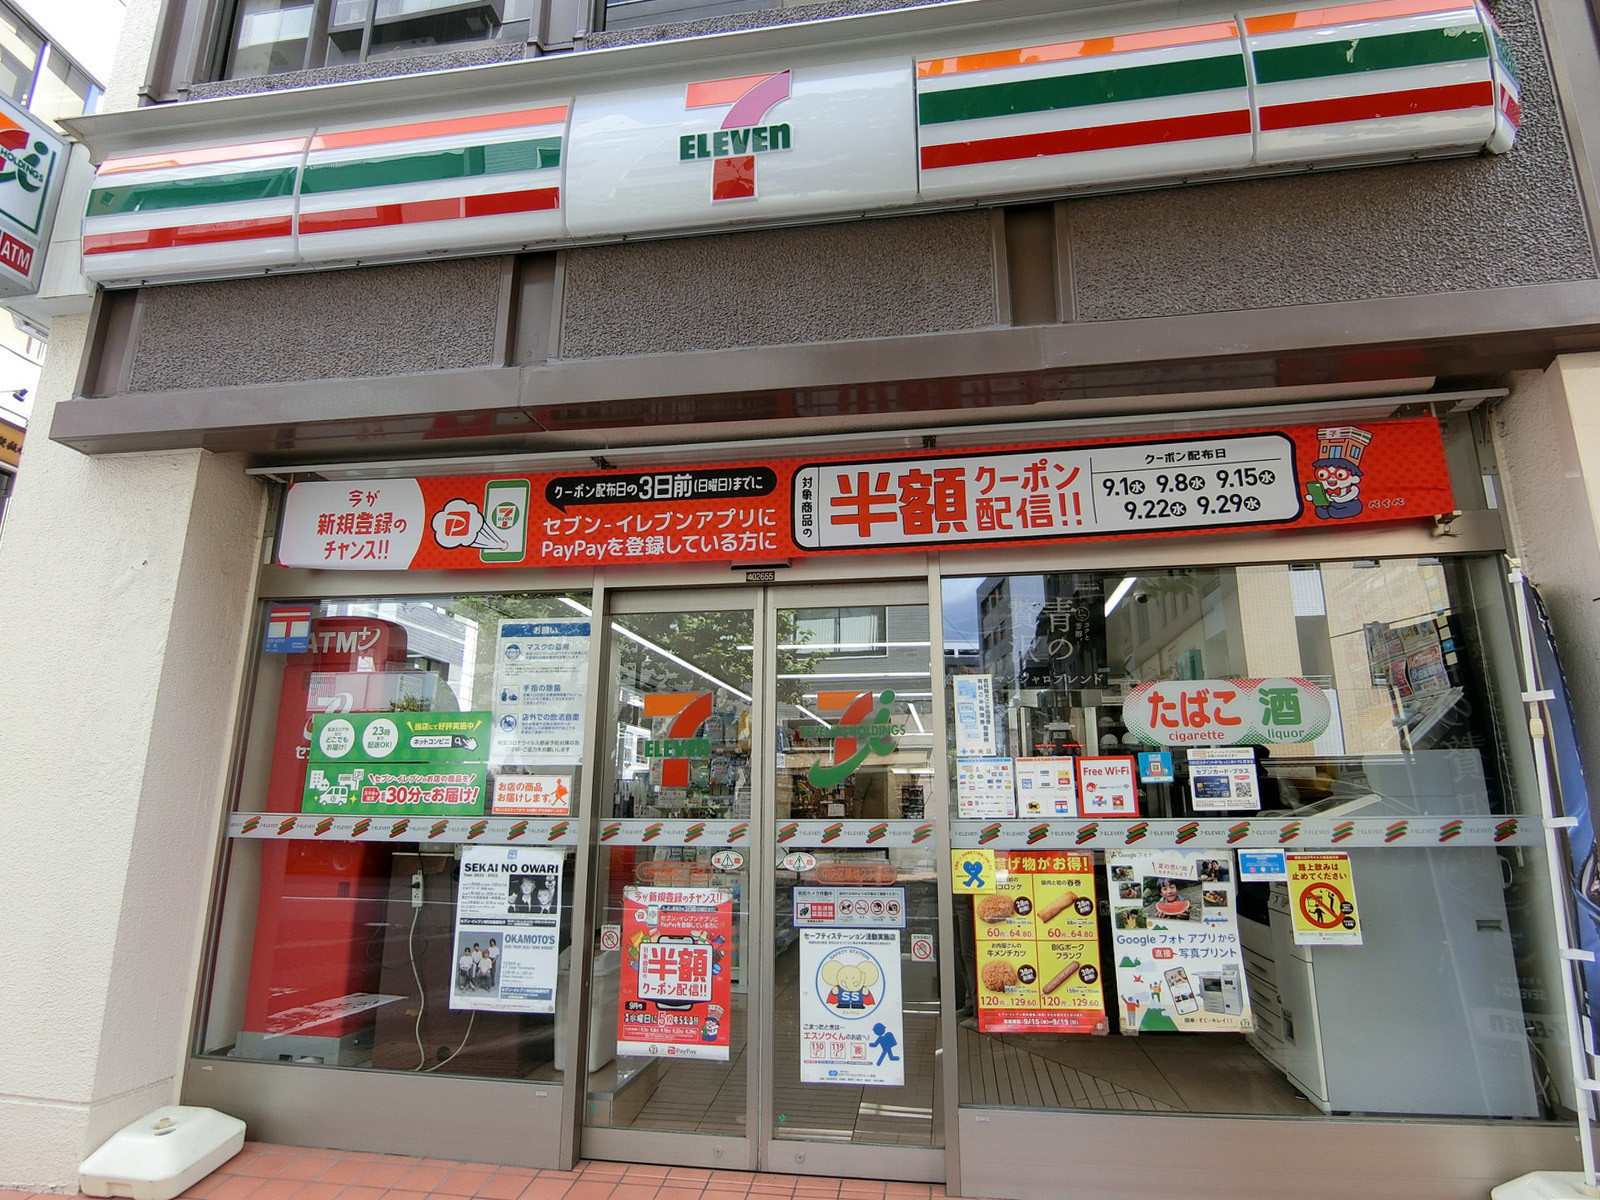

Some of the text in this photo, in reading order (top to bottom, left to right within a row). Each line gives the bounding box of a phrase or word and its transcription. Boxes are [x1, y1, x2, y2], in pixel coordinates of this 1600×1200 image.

[1, 149, 44, 183] HOLDINGS
[1, 241, 31, 270] ATM
[1144, 448, 1227, 465] クーポン配布日
[974, 458, 1082, 495] クーポン
[349, 489, 380, 508] 今が
[830, 467, 969, 538] 半額
[801, 476, 814, 538] 対象商品の
[316, 512, 407, 536] 新規登録の
[541, 532, 778, 561] PayPayを登録している方に
[747, 573, 774, 581] 402655
[1147, 688, 1242, 729] たばこ
[1258, 687, 1302, 726] 酒
[1169, 730, 1225, 743] cigarette
[1267, 728, 1305, 741] liquor
[1083, 766, 1130, 776] Free Wi-Fi
[498, 782, 543, 792] お店の商品
[464, 863, 559, 873] SEKAI NO OWARI
[1297, 863, 1339, 872] 路上飲みは
[1292, 873, 1347, 881] 止めてください
[504, 934, 556, 945] OKAMOTO'S
[1116, 934, 1156, 946] Google
[1159, 934, 1185, 945] フォト
[986, 949, 1027, 958] 牛メンチカツ
[1055, 952, 1083, 960] フランク
[1178, 948, 1237, 958] 写真プリント
[648, 947, 709, 983] 半額
[841, 992, 860, 1001] SS
[675, 1048, 697, 1056] PayPay
